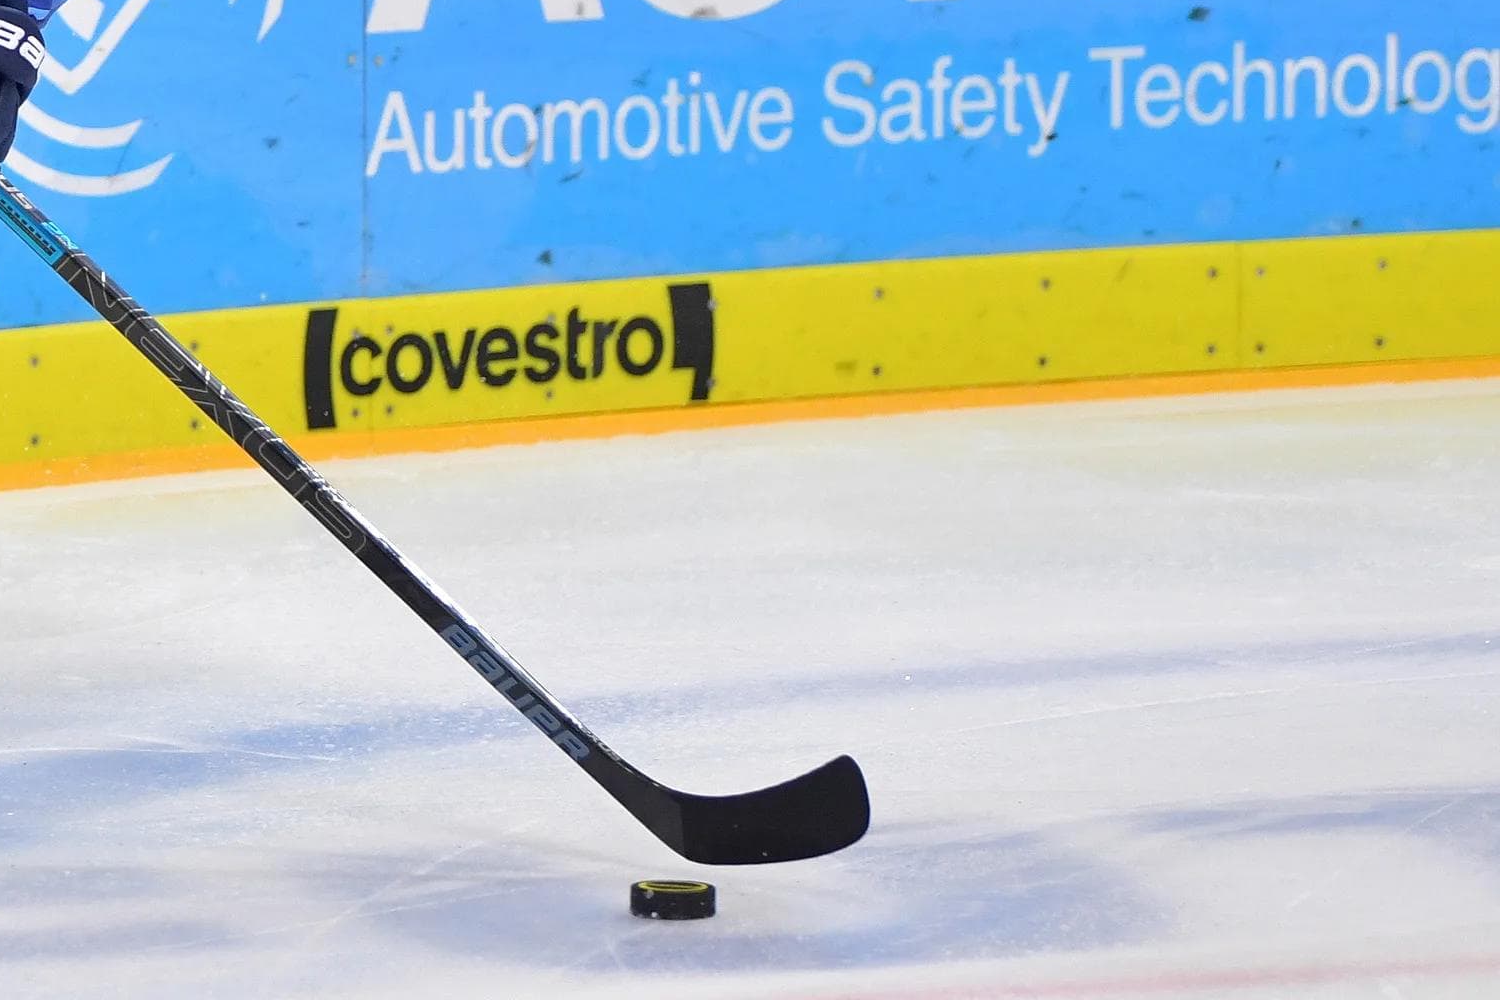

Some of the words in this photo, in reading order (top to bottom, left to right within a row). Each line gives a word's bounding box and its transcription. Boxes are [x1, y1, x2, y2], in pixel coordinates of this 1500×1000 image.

[366, 71, 794, 178] Automotive
[820, 55, 1071, 157] Safety
[1088, 33, 1500, 135] Technolog
[340, 306, 665, 397] covestro
[440, 623, 591, 762] BAUER
